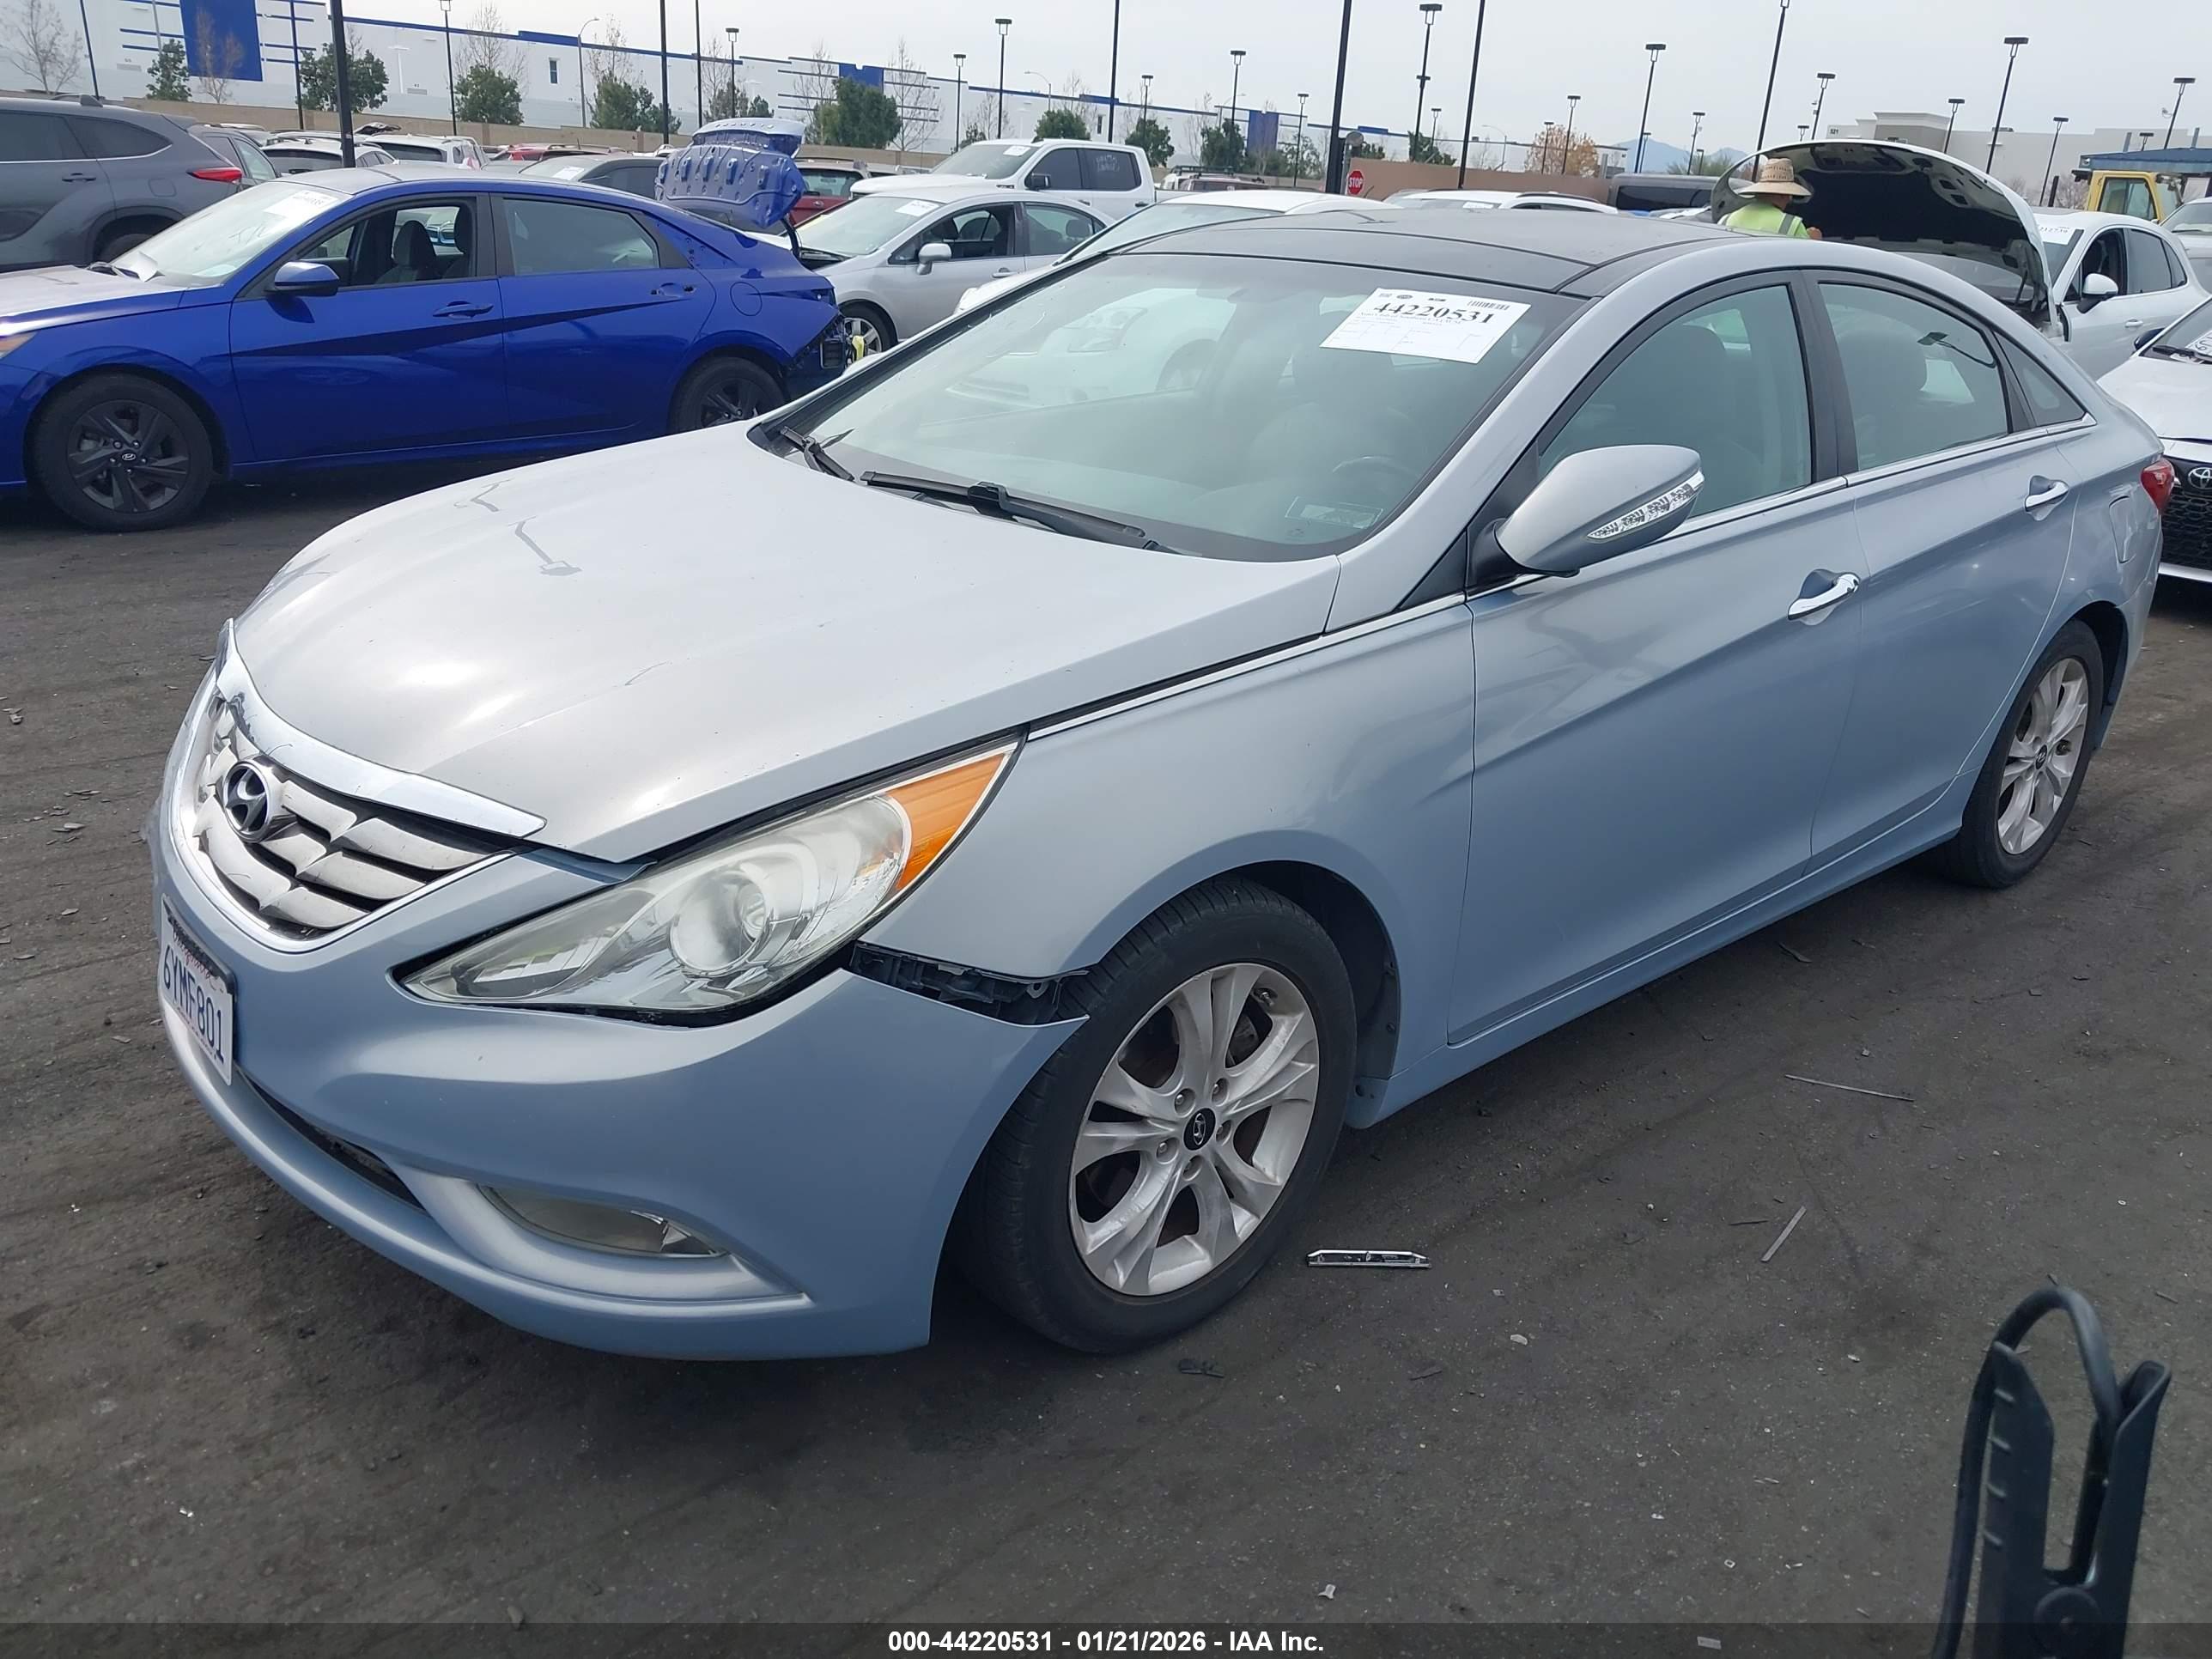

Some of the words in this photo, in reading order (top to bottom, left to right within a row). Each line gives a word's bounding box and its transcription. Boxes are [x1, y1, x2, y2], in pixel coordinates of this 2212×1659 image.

[1349, 177, 1364, 188] STOP
[1373, 302, 1496, 325] 44220531
[163, 945, 224, 1065] 6YMF801
